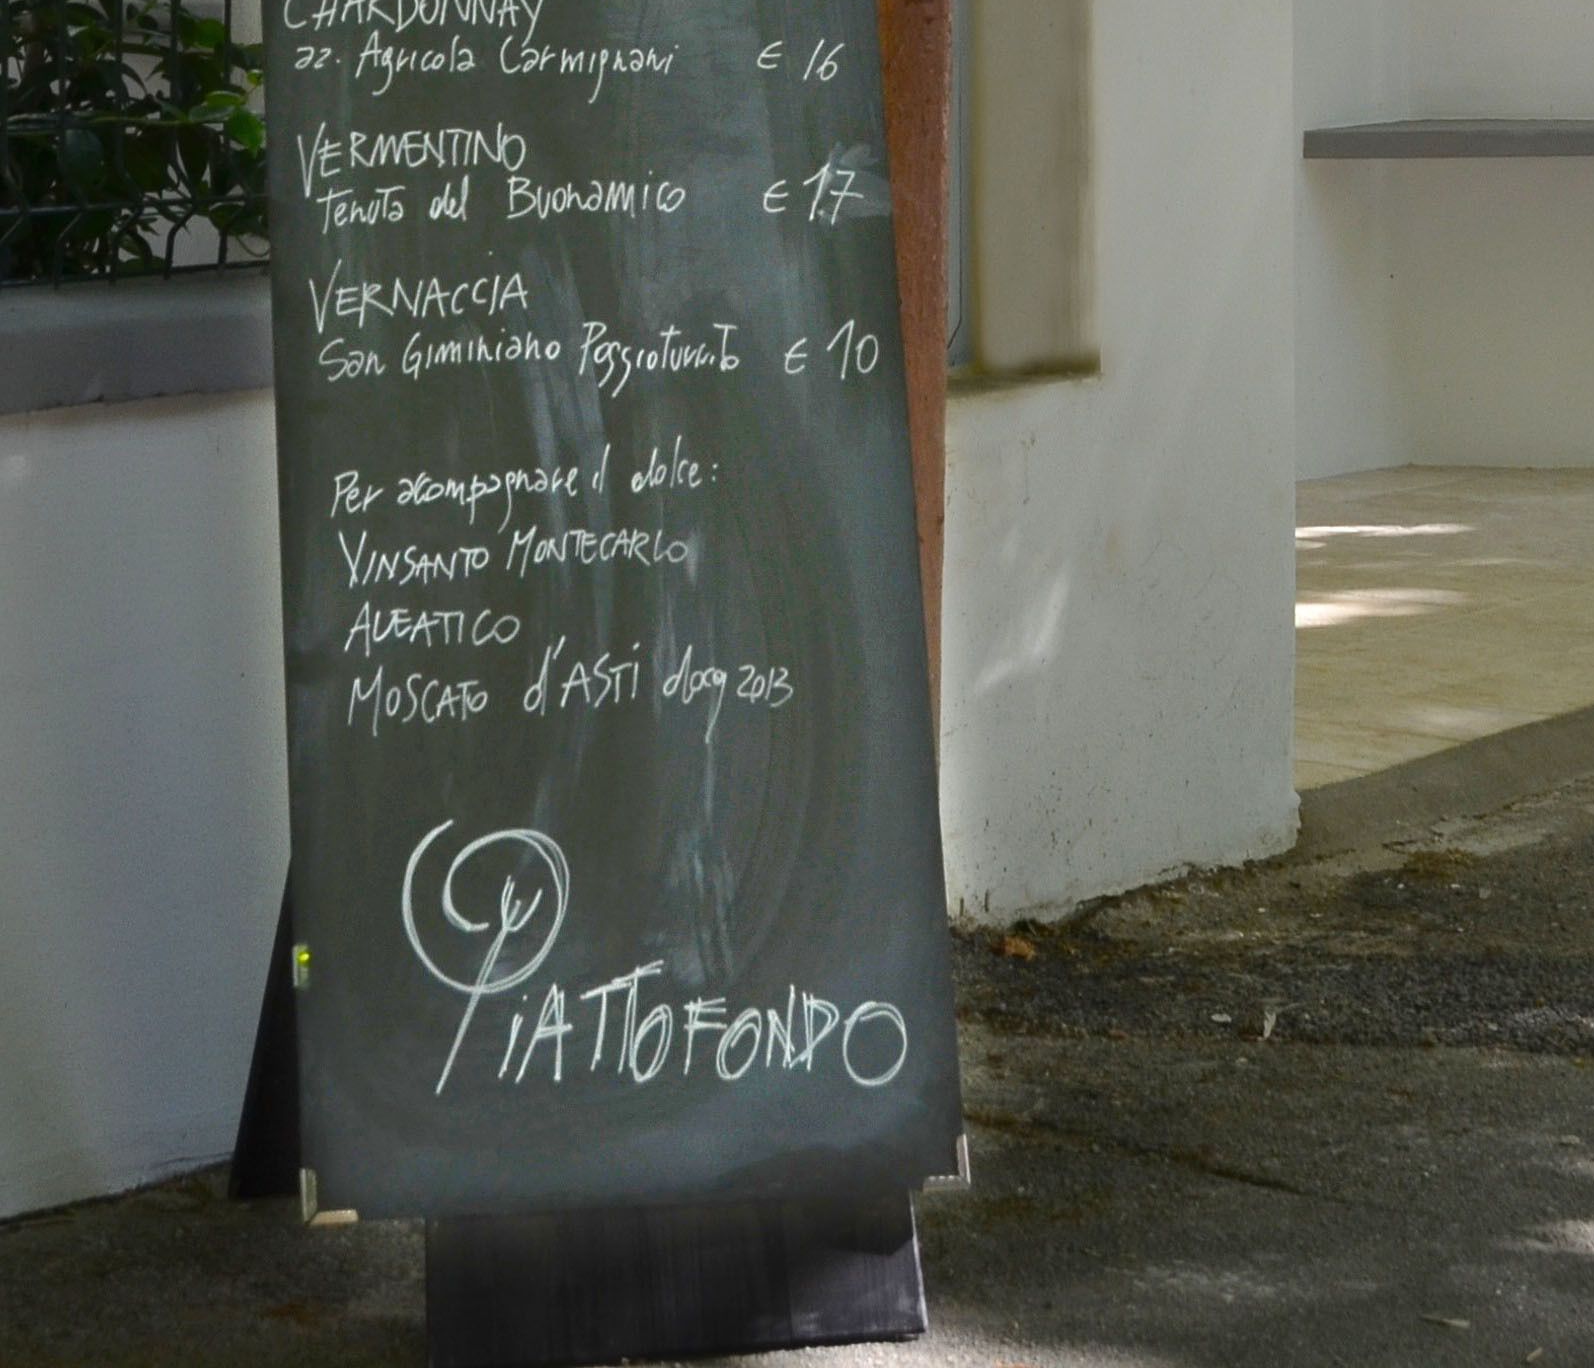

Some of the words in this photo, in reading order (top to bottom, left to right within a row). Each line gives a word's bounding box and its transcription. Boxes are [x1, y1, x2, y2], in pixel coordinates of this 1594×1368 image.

[354, 30, 475, 95] Agricola
[499, 37, 679, 104] Carmignani
[804, 40, 844, 82] 16
[316, 185, 403, 234] Tenuta
[429, 175, 467, 222] del
[507, 171, 685, 219] Buonamico
[802, 162, 864, 224] 17
[309, 260, 528, 333] VERNACCIA
[318, 339, 385, 381] San
[827, 320, 879, 380] 10
[331, 471, 382, 518] Per
[593, 444, 611, 493] il
[736, 664, 793, 708] 2013
